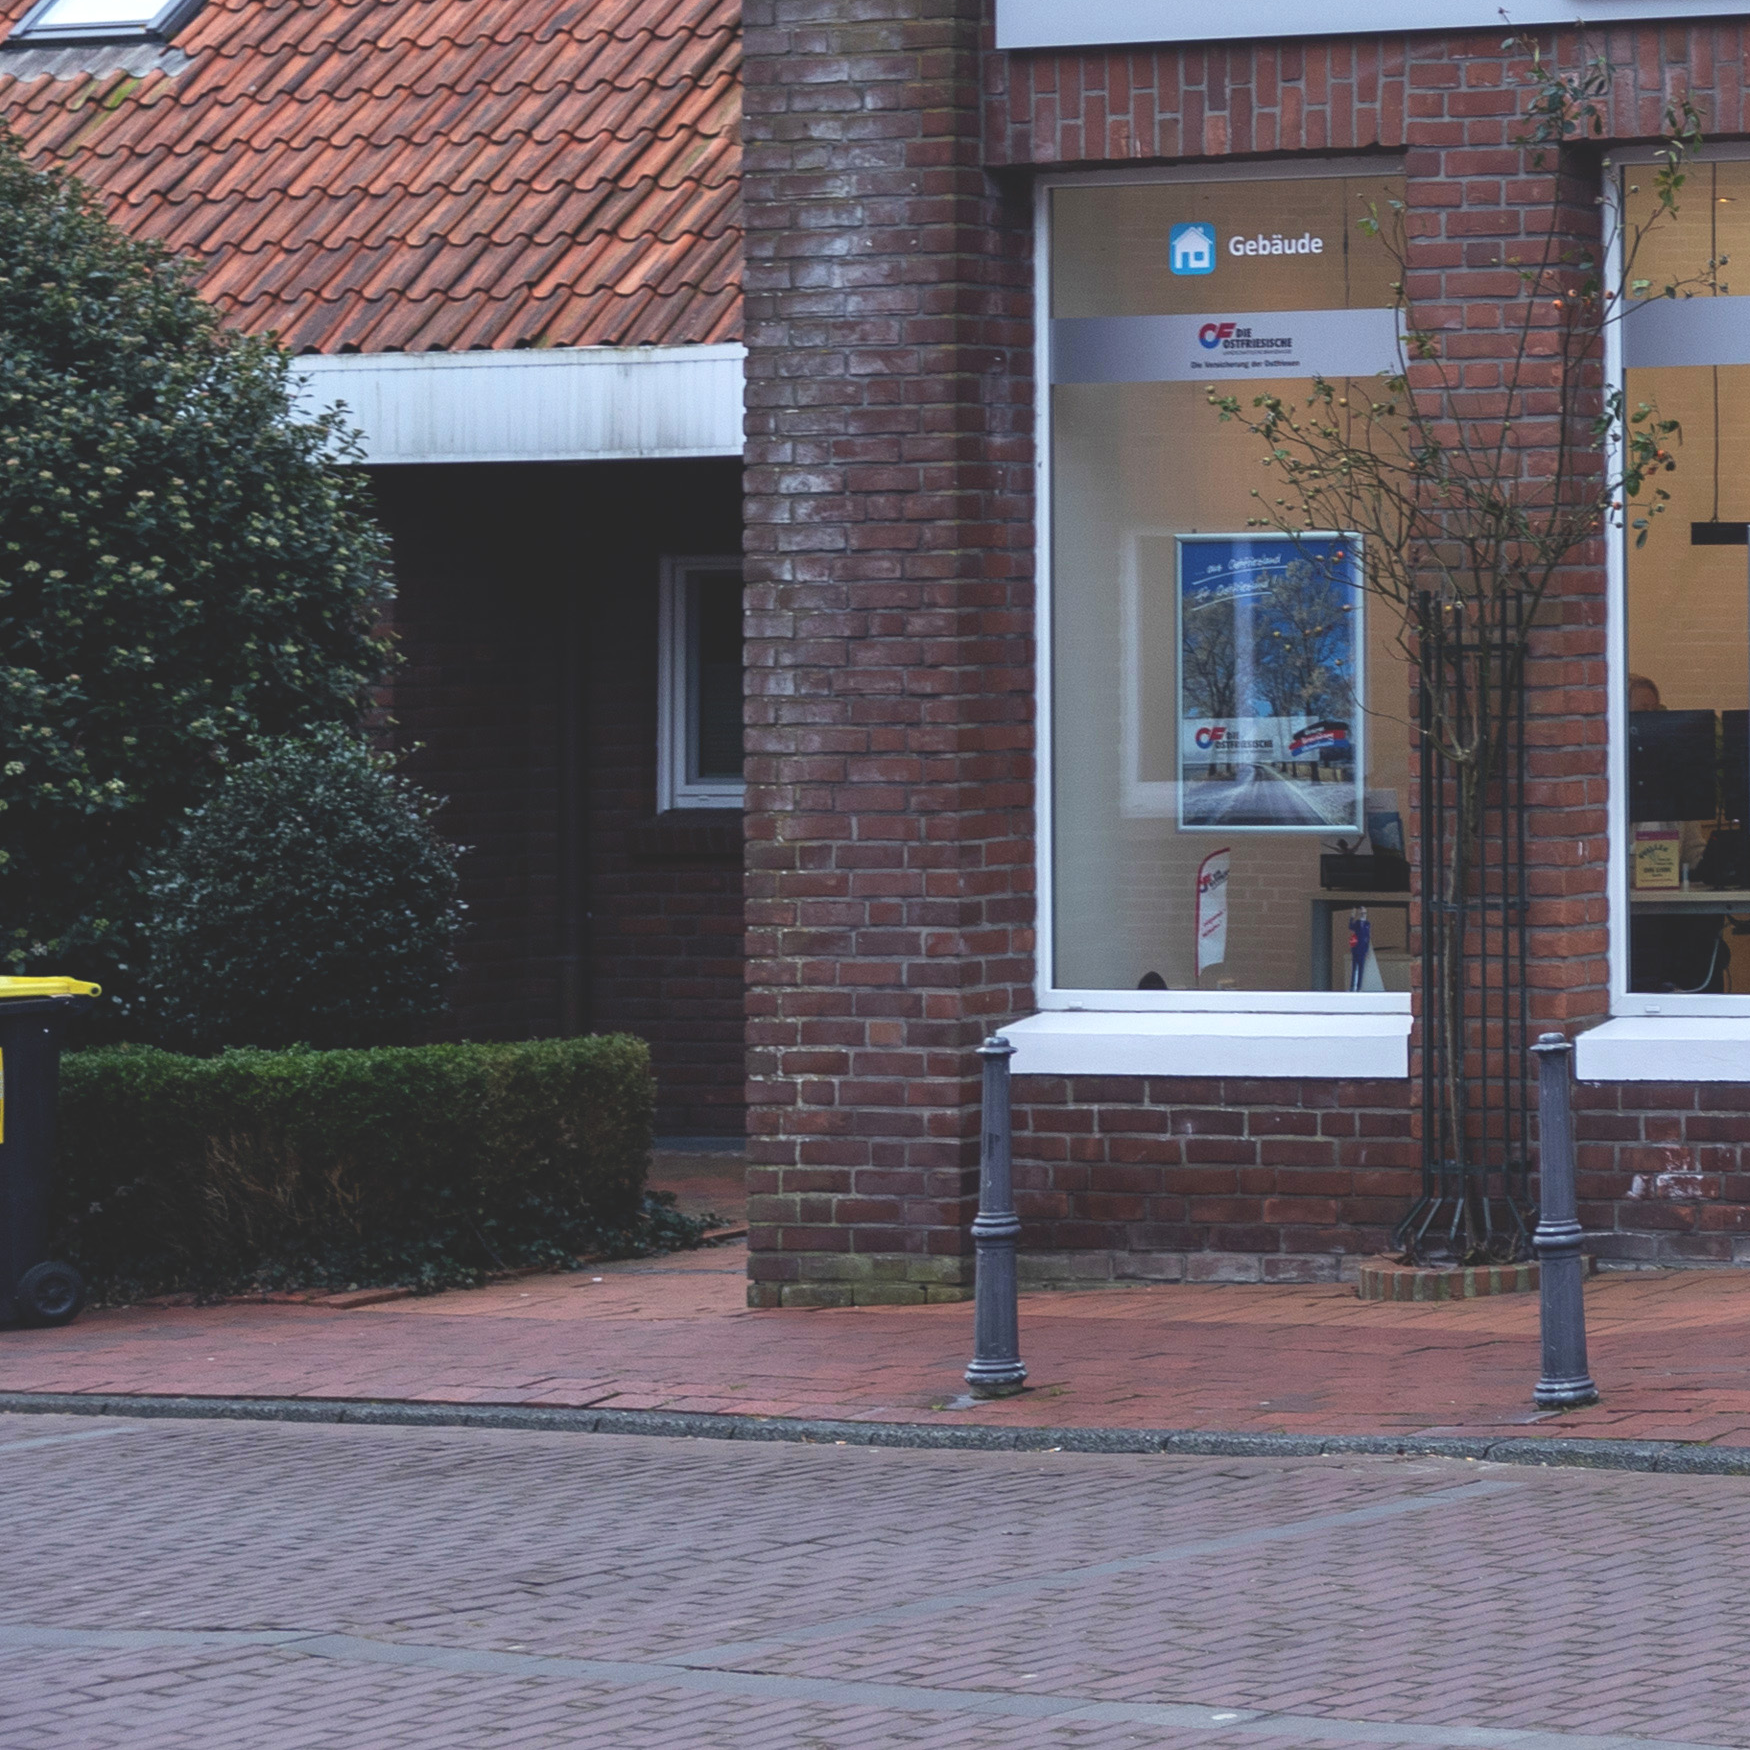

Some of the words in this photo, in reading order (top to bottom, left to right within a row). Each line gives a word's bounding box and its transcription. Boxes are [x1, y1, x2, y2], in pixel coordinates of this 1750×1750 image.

[1229, 233, 1323, 256] Gebäude
[1236, 328, 1252, 338] DIE
[1223, 338, 1292, 348] OSTFRIESISCHE
